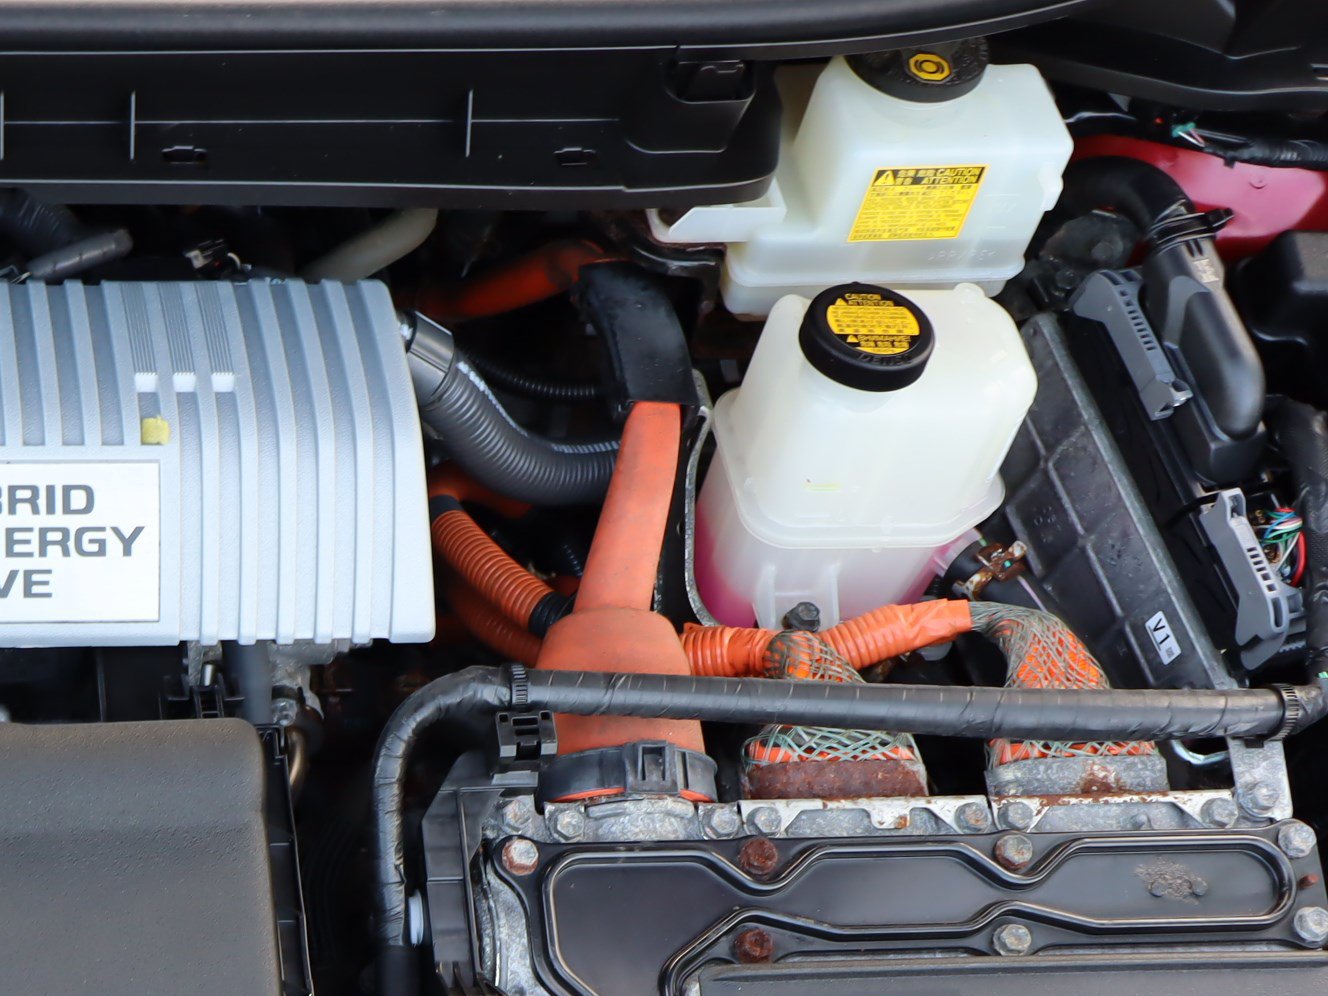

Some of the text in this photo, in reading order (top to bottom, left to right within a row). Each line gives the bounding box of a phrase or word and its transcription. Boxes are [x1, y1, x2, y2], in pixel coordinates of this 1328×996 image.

[936, 167, 982, 177] CAUTION
[920, 176, 978, 185] ATTENTION
[1153, 617, 1170, 645] V1
